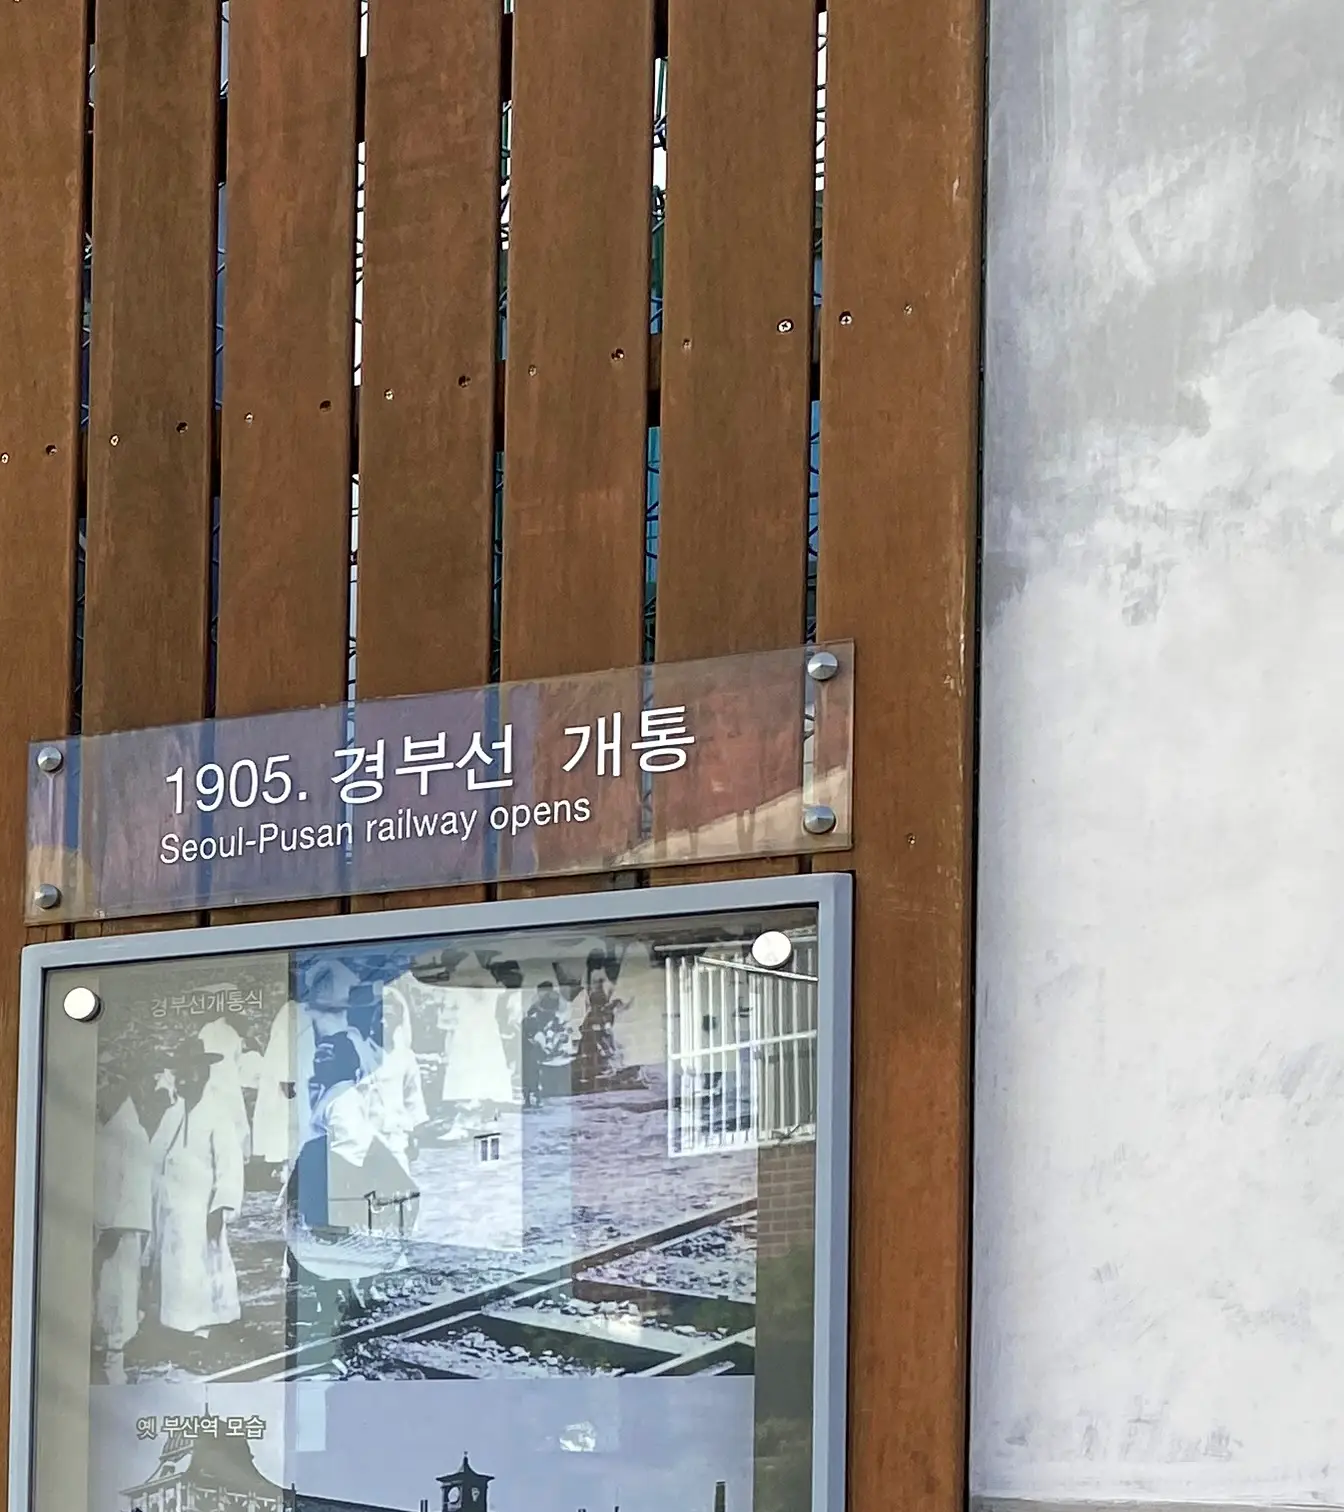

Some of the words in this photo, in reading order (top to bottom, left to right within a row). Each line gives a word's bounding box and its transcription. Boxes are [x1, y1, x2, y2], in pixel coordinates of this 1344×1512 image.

[166, 755, 308, 814] 1905.
[331, 723, 515, 806] 경부선
[563, 705, 695, 777] 개통
[159, 820, 353, 865] Seoul-Pusan
[365, 809, 478, 844] railway
[490, 796, 591, 834] opens
[151, 988, 263, 1018] 경부선개통식
[137, 1418, 156, 1439] 옛
[162, 1416, 220, 1438] 부산역
[225, 1417, 266, 1438] 모습
